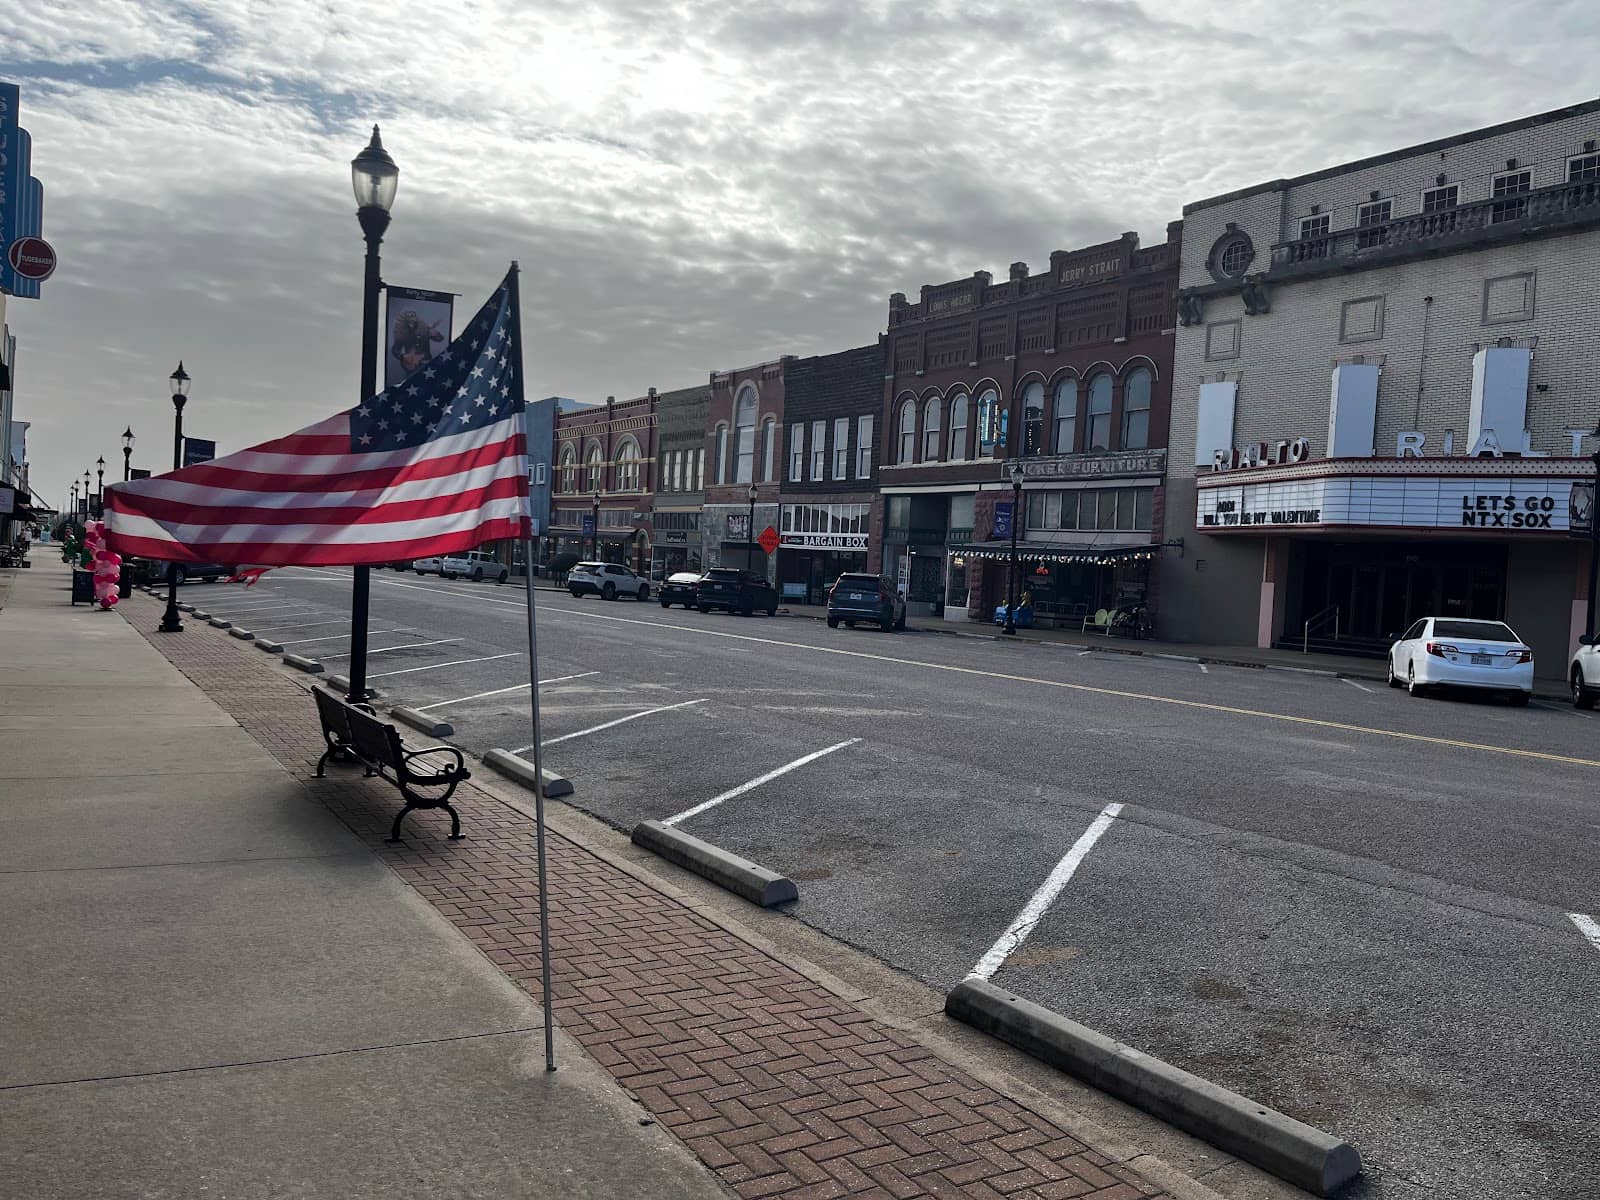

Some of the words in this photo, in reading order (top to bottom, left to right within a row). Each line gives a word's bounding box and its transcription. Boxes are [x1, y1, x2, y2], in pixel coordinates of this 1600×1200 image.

[1060, 267, 1085, 282] JERRY
[1088, 258, 1121, 276] STRAIT
[1212, 437, 1310, 471] RIALTO
[1072, 457, 1158, 474] FURNITURE
[1462, 496, 1516, 511] LETS
[1525, 496, 1555, 512] GO
[1223, 513, 1238, 525] YOU
[1241, 512, 1251, 524] BE
[1254, 511, 1266, 524] MY
[1271, 509, 1320, 523] VALENTINE
[1462, 512, 1504, 527] NTX
[1512, 512, 1552, 528] SOX
[803, 536, 843, 547] BARGAIN
[846, 537, 866, 548] BOX
